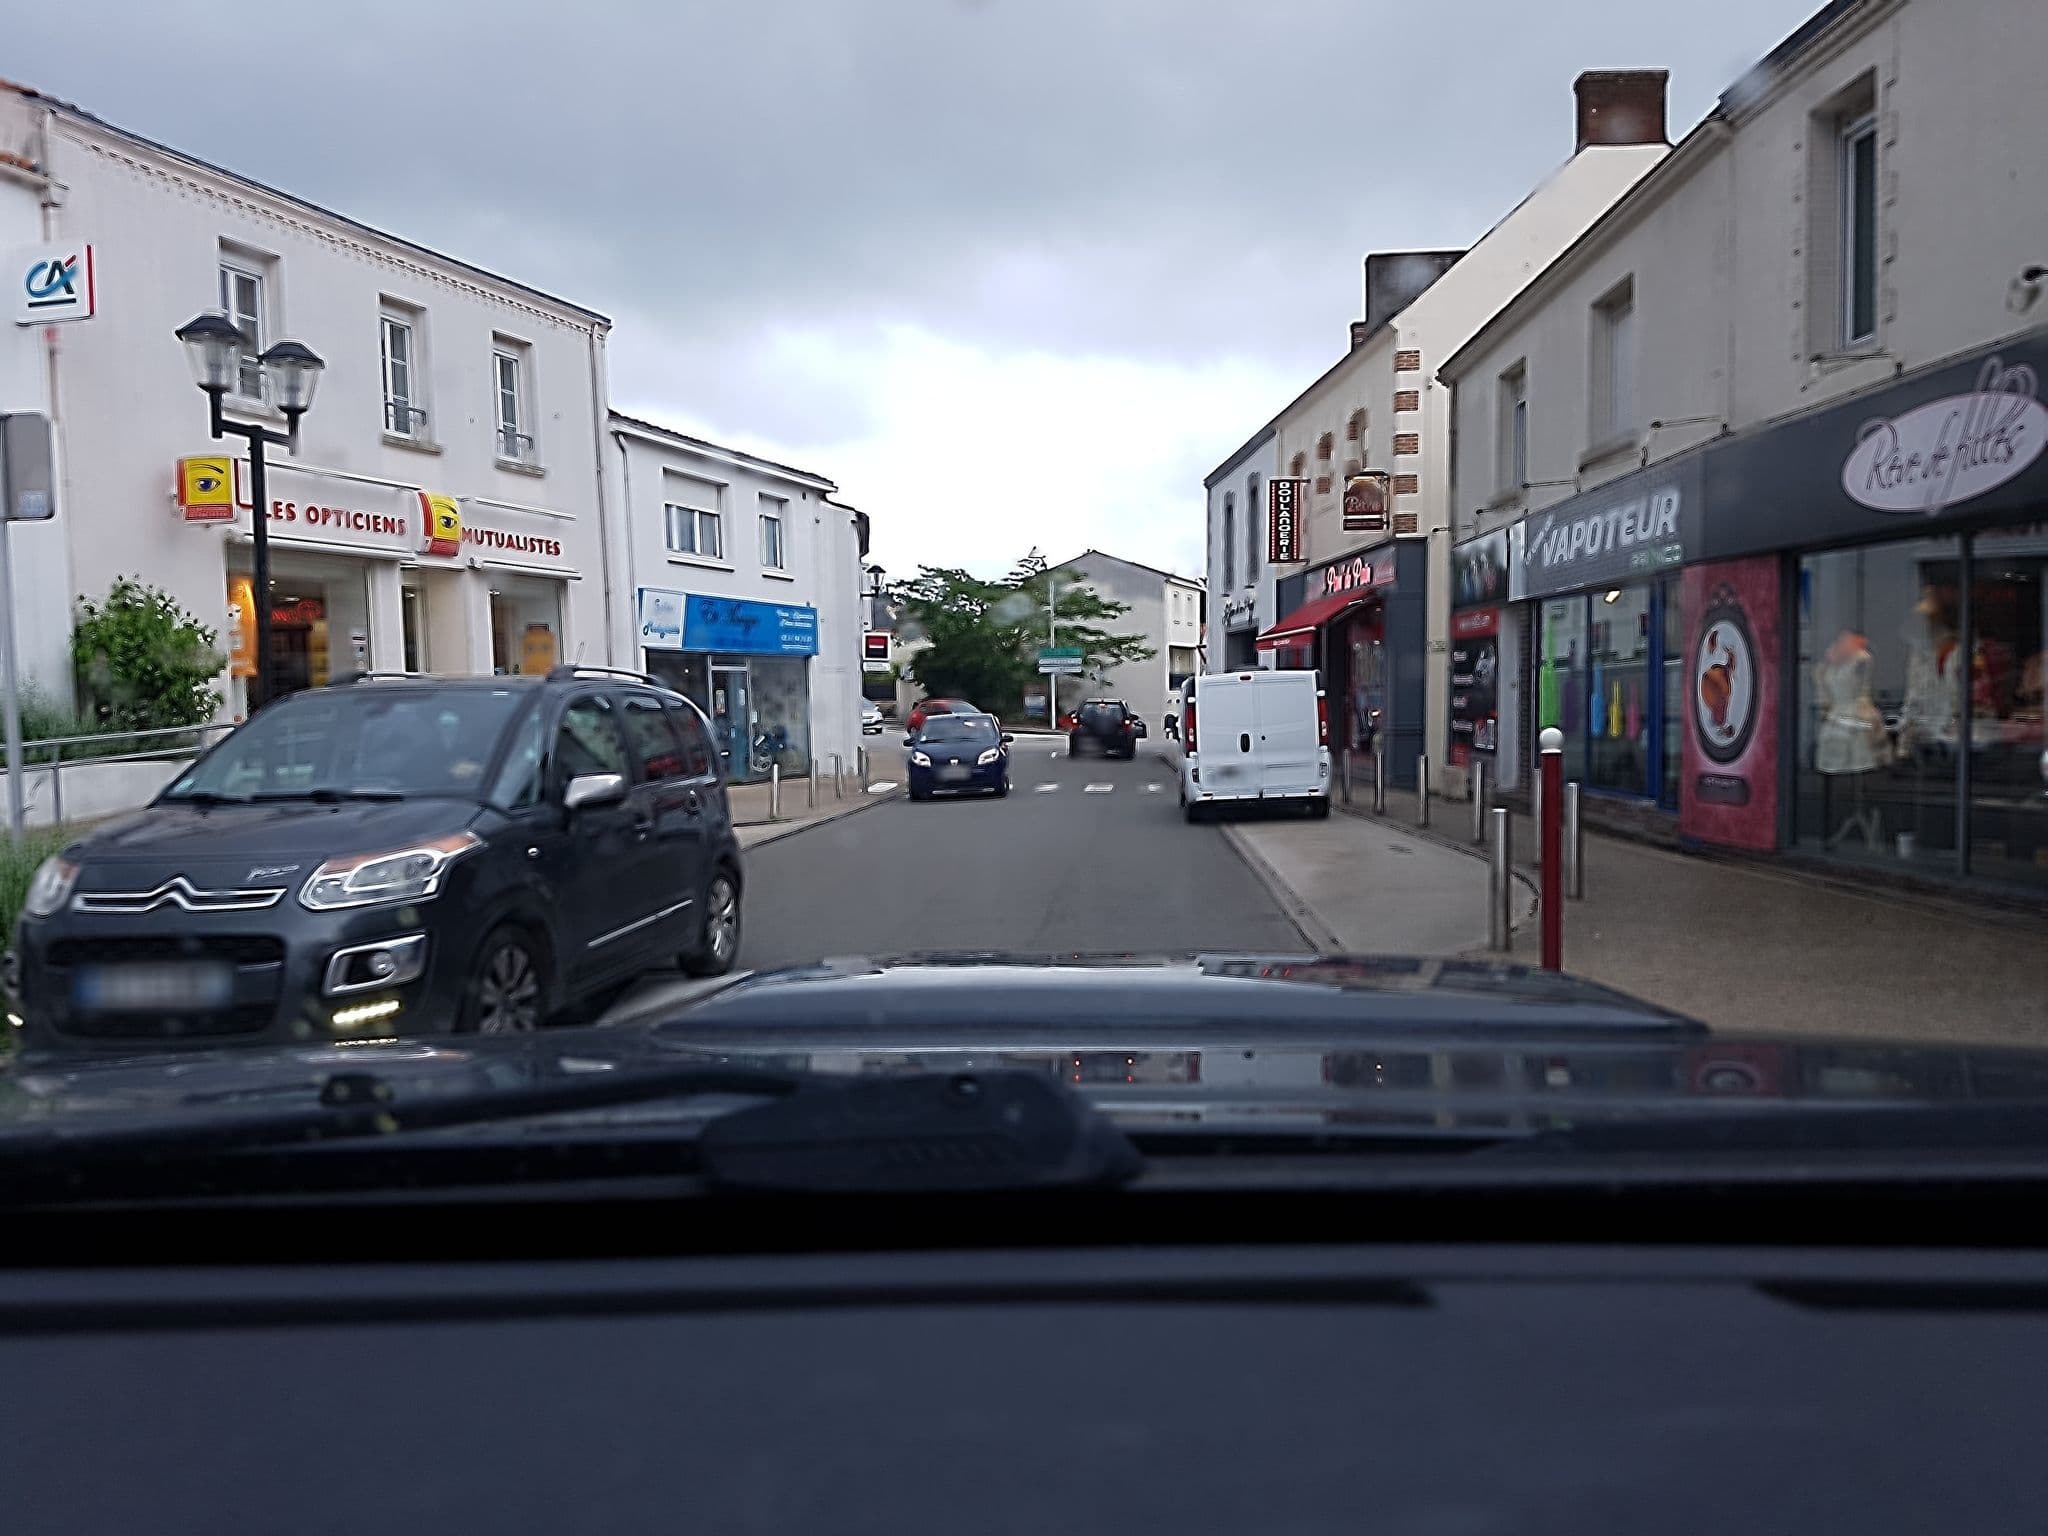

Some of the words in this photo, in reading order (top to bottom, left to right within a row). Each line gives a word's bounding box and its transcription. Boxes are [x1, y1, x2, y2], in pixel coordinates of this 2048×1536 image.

[265, 500, 297, 522] ES
[305, 505, 407, 536] OPTICIENS
[461, 526, 561, 556] MUTUALISTES
[1278, 481, 1291, 560] BOULANGERIE
[1543, 488, 1681, 567] VAPOTEUR
